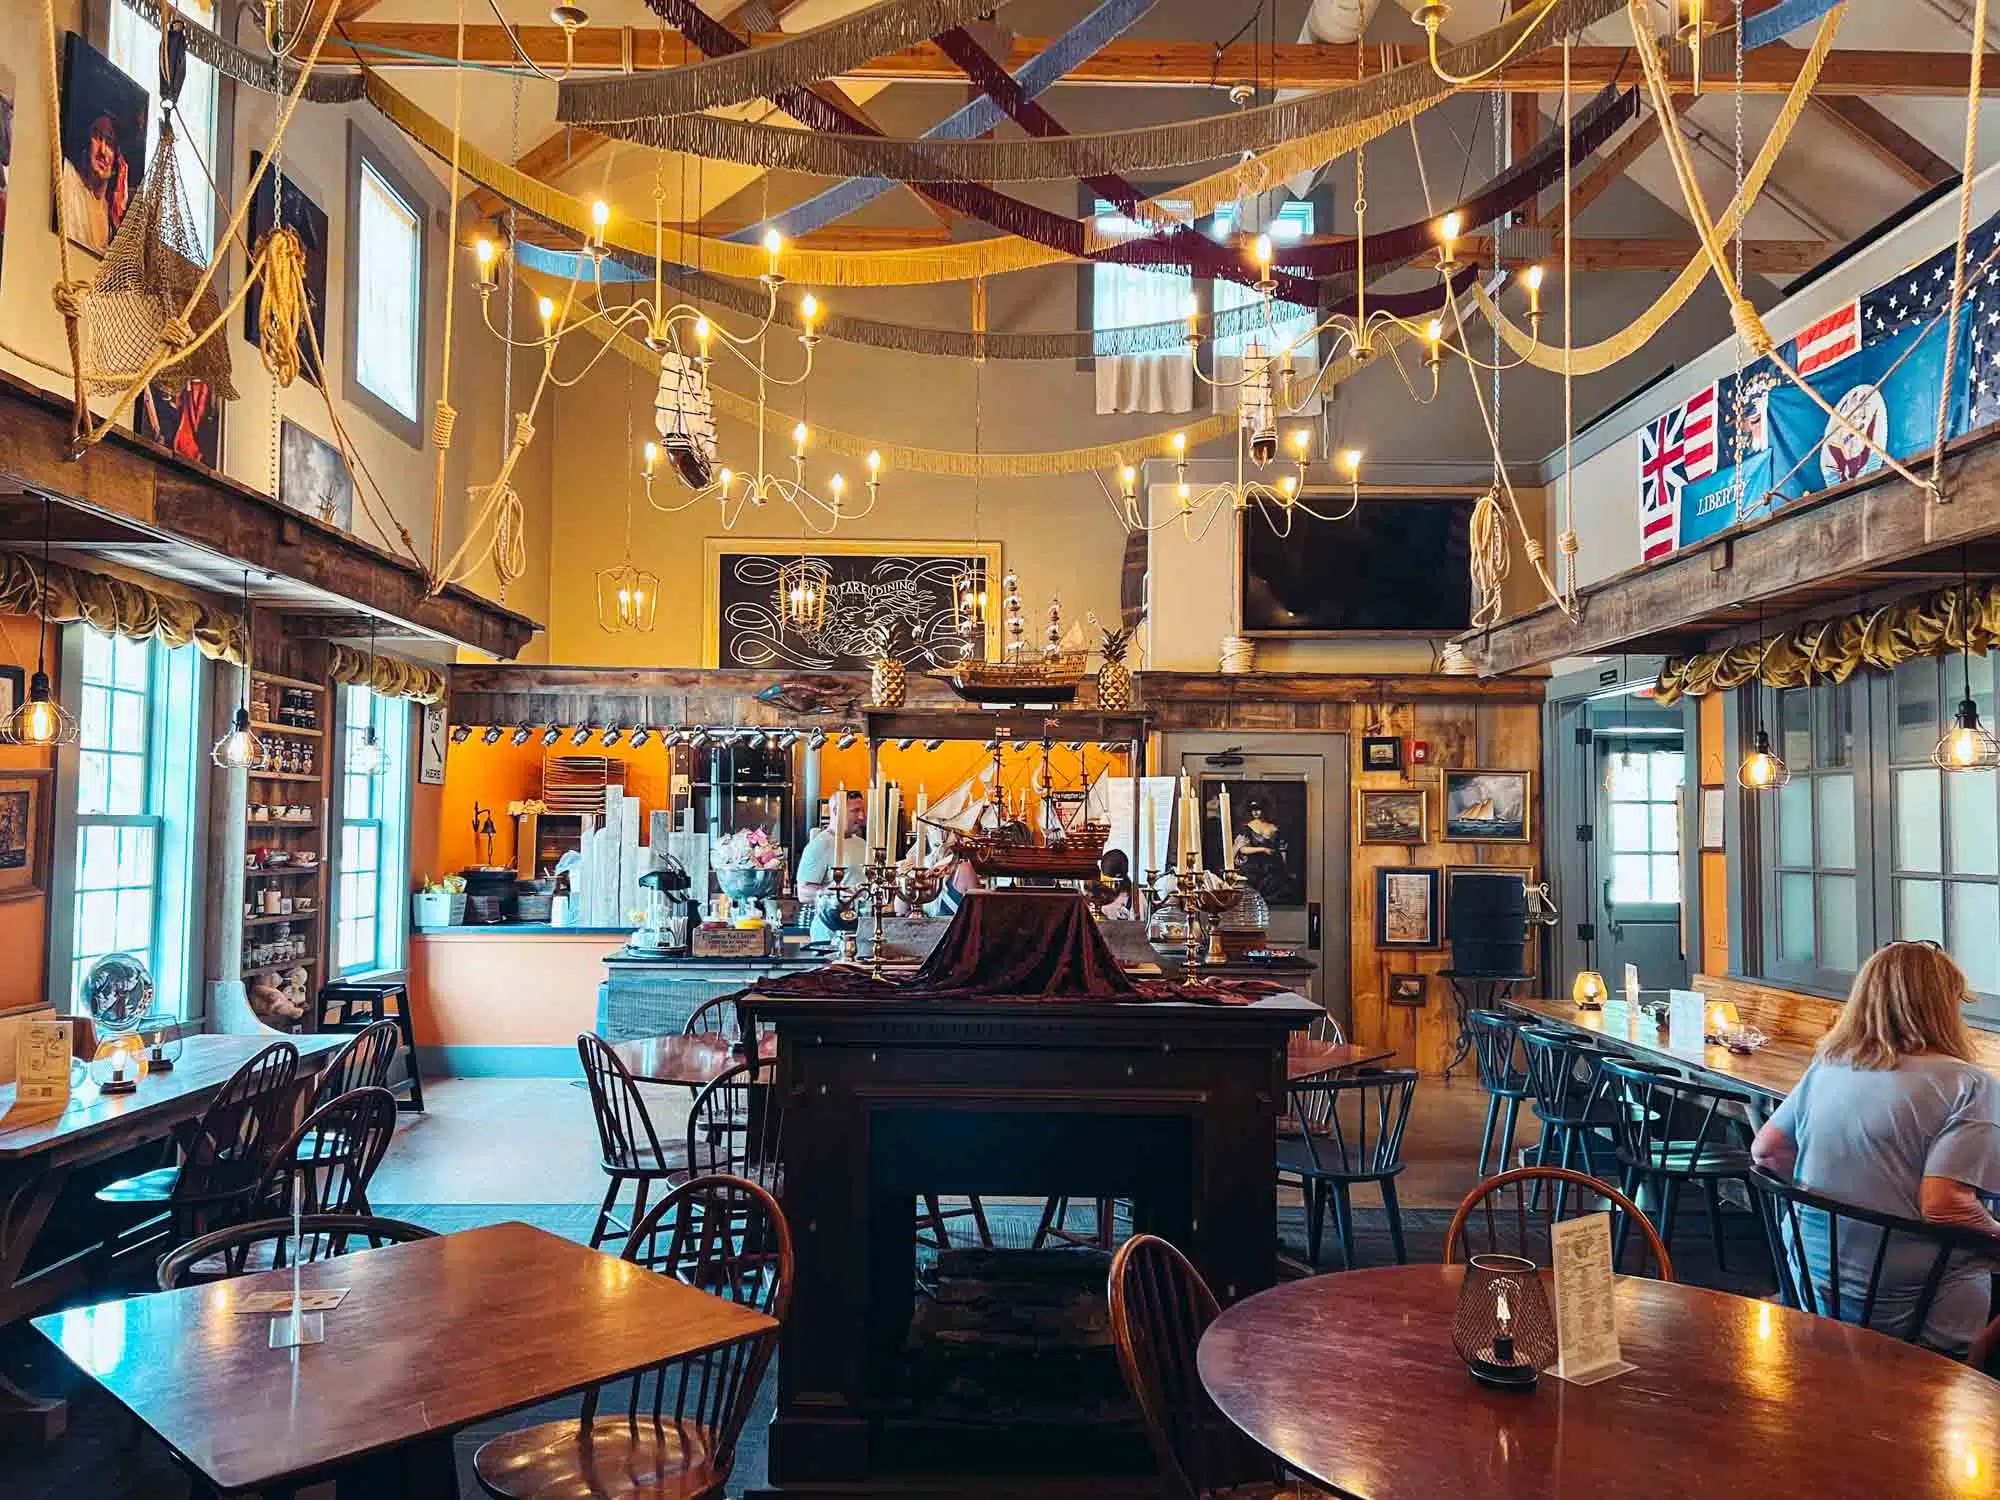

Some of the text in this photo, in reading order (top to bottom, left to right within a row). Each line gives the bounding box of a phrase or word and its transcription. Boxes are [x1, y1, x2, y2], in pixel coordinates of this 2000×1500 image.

[840, 581, 870, 594] FARE
[875, 580, 916, 595] DINING
[428, 707, 443, 723] PICK
[431, 721, 440, 734] UP
